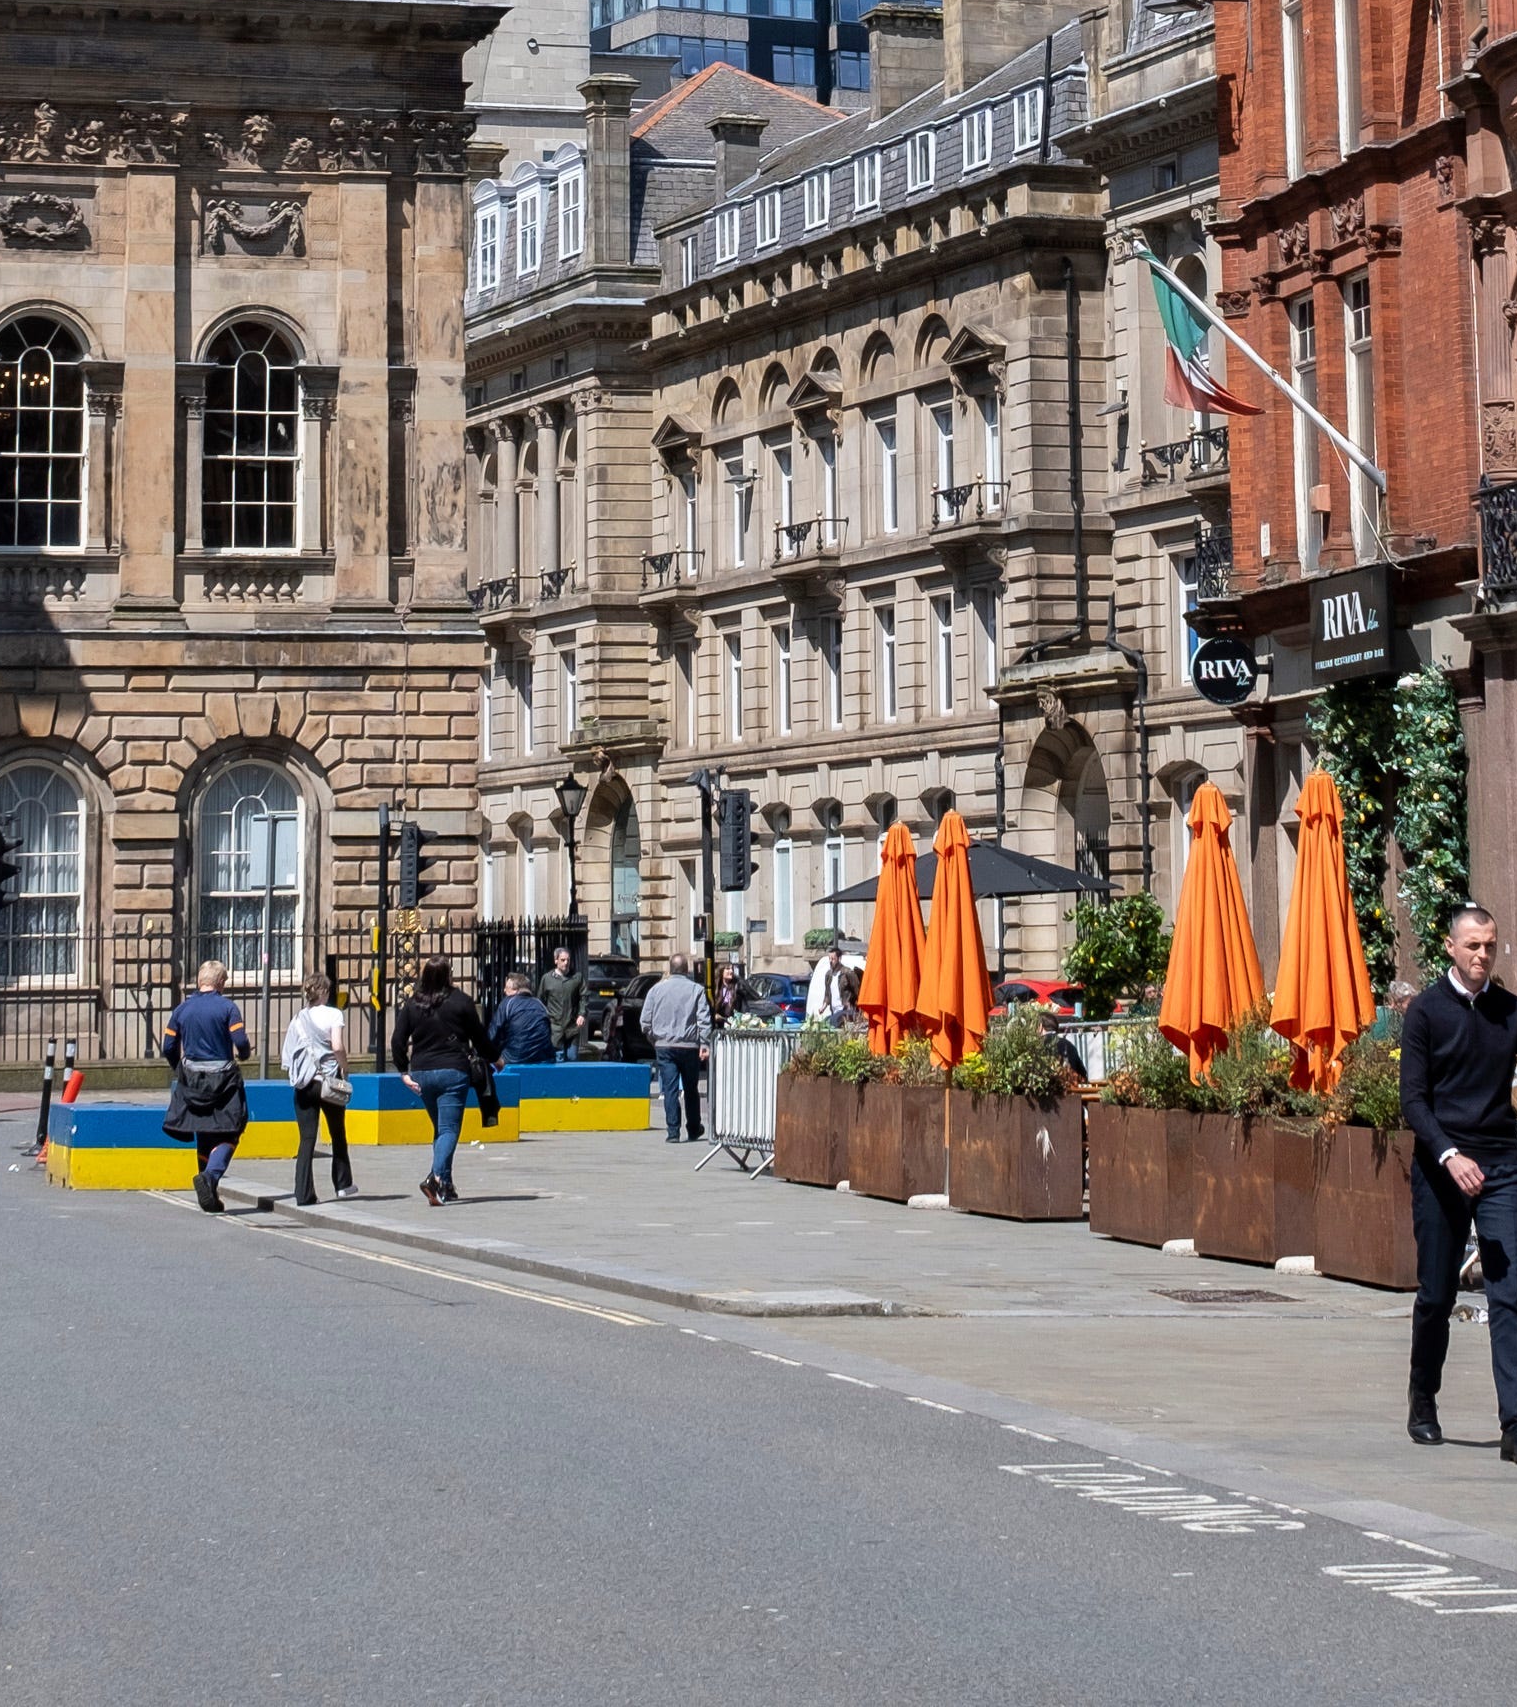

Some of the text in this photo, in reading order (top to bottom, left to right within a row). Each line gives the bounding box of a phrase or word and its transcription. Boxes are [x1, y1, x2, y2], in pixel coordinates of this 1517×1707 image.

[1322, 592, 1367, 642] RIVA
[1199, 658, 1253, 680] RIVA
[998, 1463, 1307, 1533] LOADING
